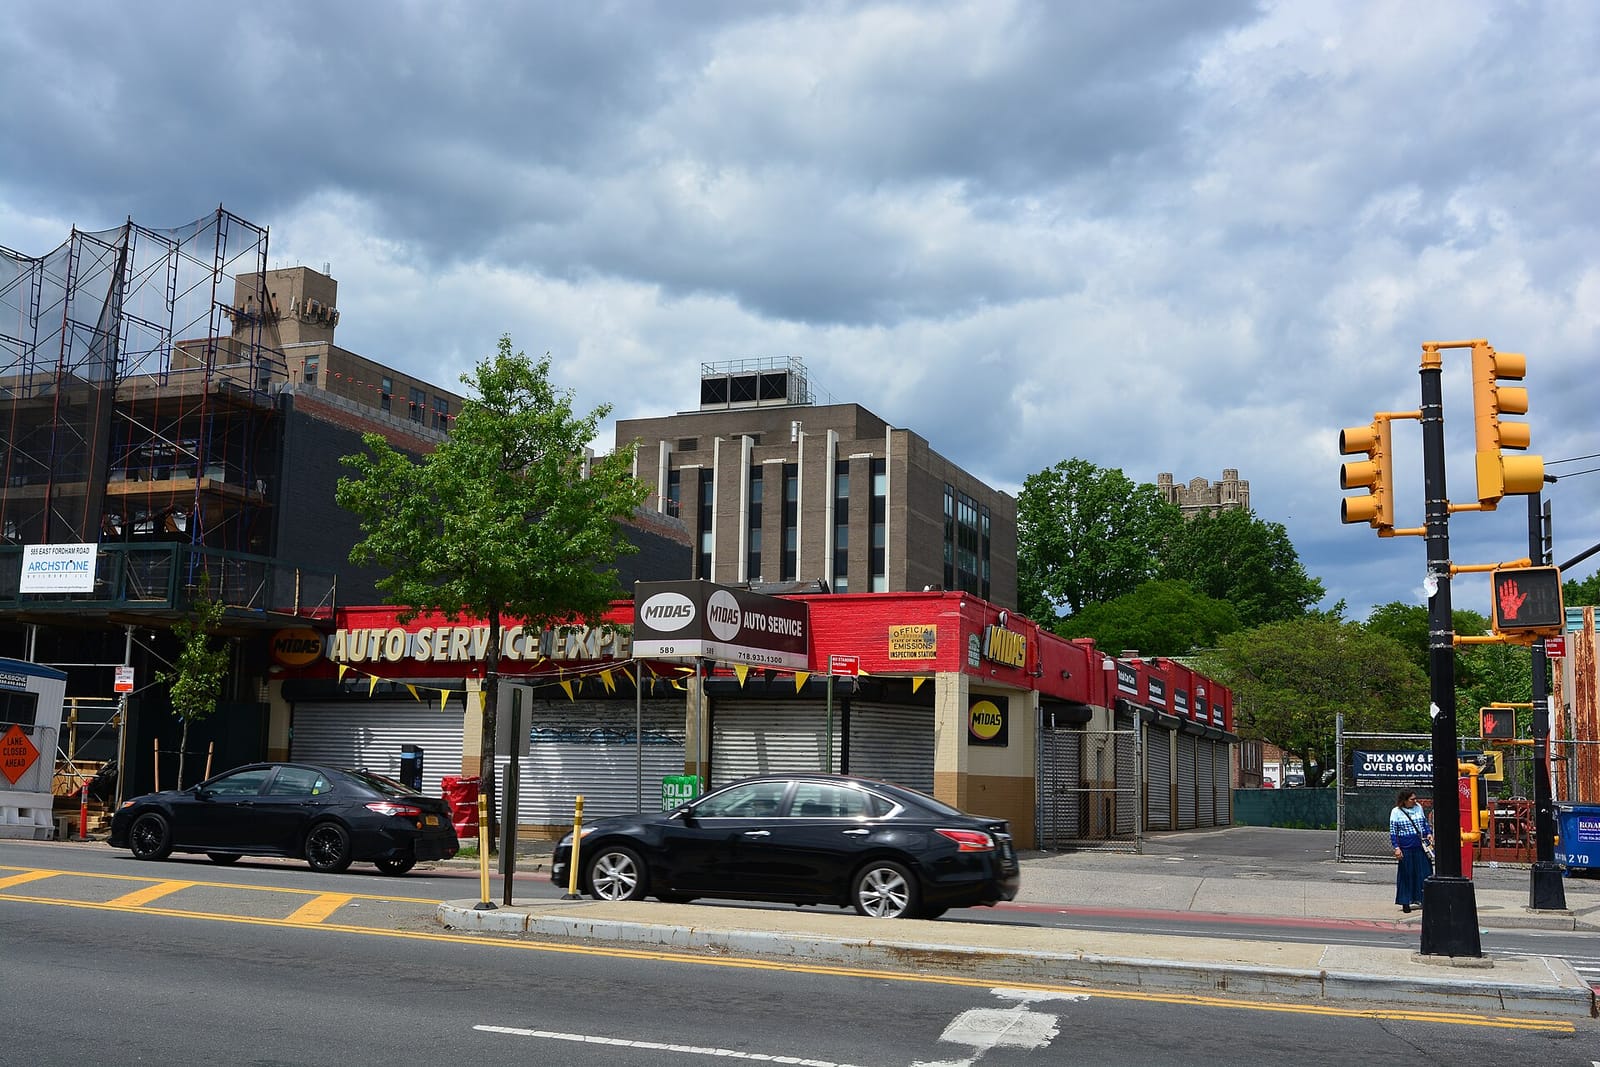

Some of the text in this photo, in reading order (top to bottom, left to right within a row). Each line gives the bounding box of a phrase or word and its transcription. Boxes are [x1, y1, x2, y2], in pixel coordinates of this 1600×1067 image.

[39, 547, 52, 555] EAST
[52, 547, 76, 555] FORDHAM
[28, 560, 89, 571] ARCHSTONE
[646, 605, 692, 619] MIDAS
[710, 605, 802, 637] MIDAS AUTO SERVICE
[274, 638, 320, 653] MIDAS
[331, 628, 406, 662] AUTO
[988, 625, 1026, 667] MIDAS
[738, 651, 782, 664] 718.933.1300
[972, 712, 1001, 727] MIDAS
[8, 737, 23, 746] LANE
[3, 748, 26, 756] CLOSED
[1366, 754, 1384, 762] FIX
[1387, 754, 1415, 762] NOW
[1418, 754, 1425, 762] &
[6, 758, 26, 768] AHEAD
[1363, 763, 1394, 772] OVER
[1396, 763, 1403, 772] 6
[663, 784, 692, 797] SOLD
[1568, 854, 1575, 864] 2
[1577, 854, 1589, 864] YD
